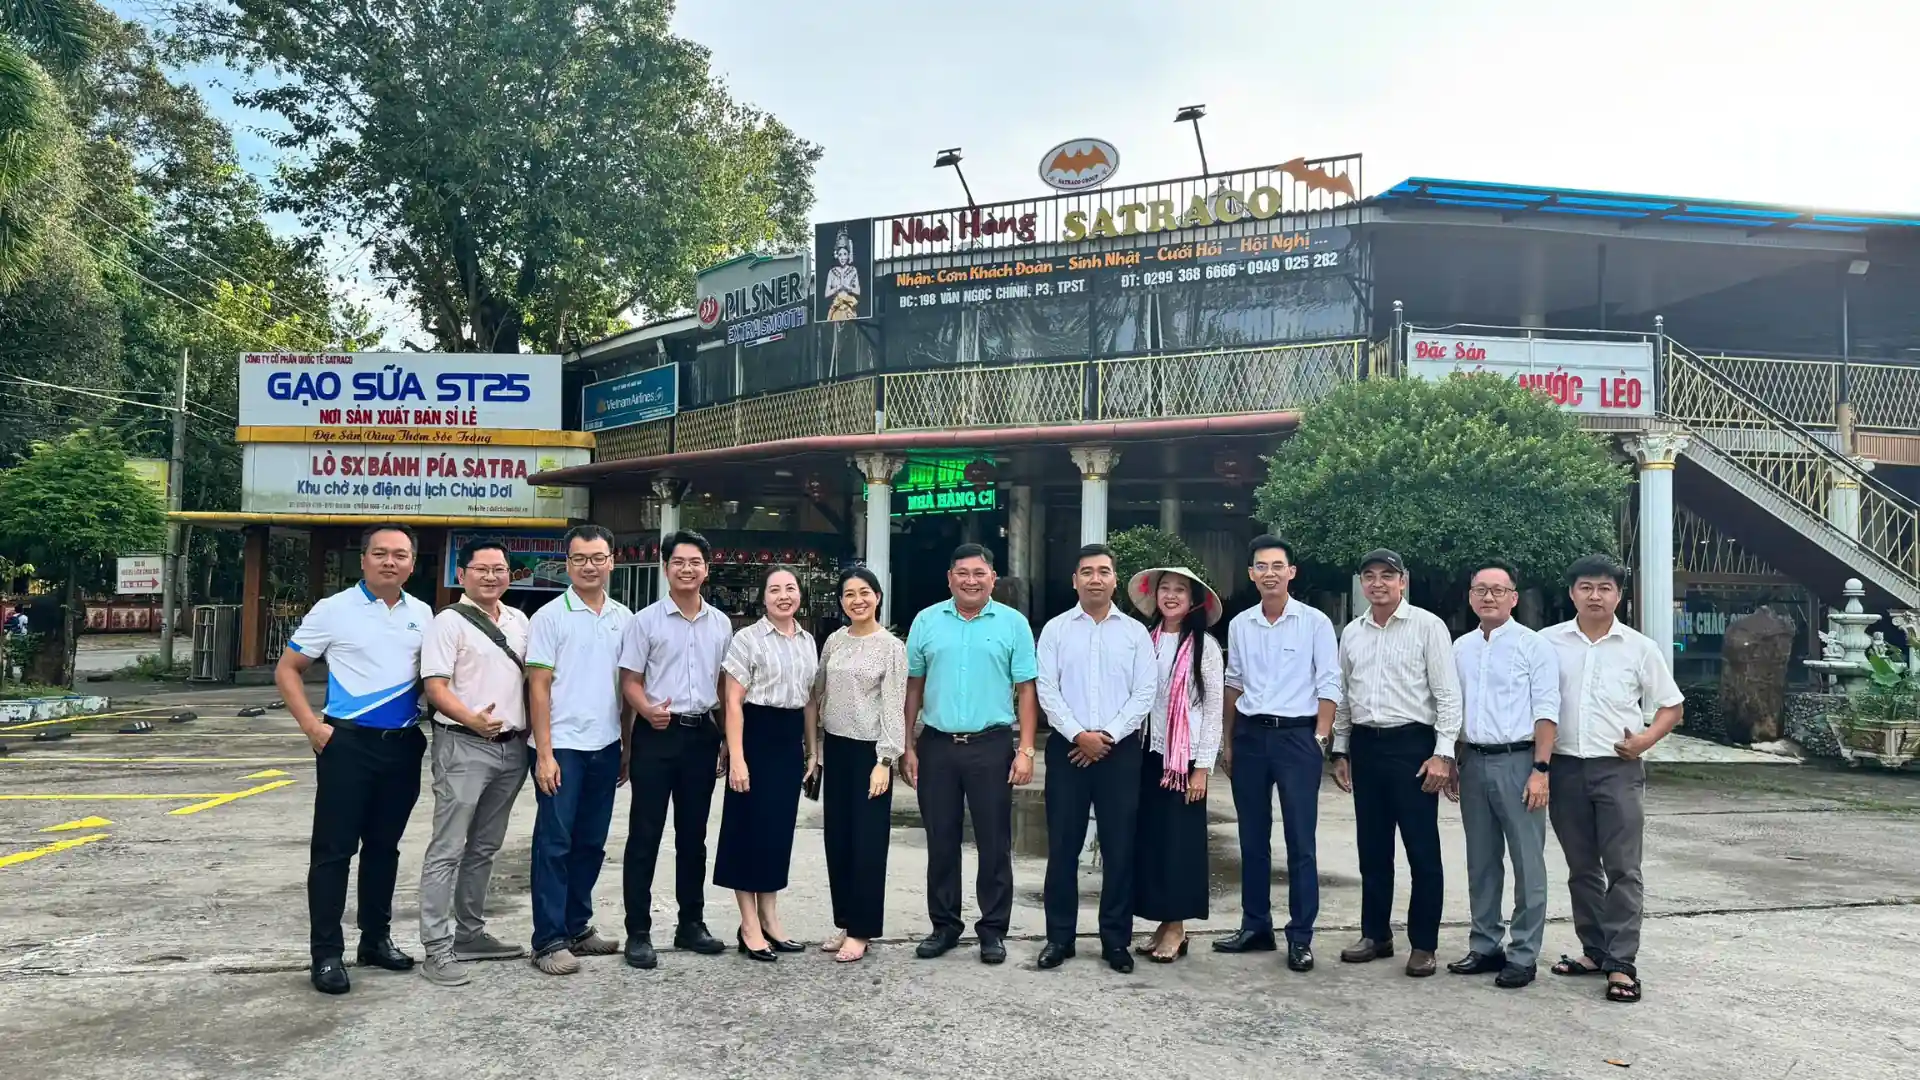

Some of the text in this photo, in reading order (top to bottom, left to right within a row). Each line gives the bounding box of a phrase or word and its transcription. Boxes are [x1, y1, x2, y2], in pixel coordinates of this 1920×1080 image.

[892, 208, 1037, 246] Nhà Hàng
[1062, 185, 1282, 242] SATRACO
[896, 231, 1311, 289] Nhận: Cơm Khách Đoàn Sinh Nhật Cưới Hỏi Hội Nghị
[1121, 252, 1338, 288] ĐT: 0299 368 6666 0949 025 282
[724, 270, 804, 322] PILSNER
[940, 287, 960, 304] VĂN
[963, 288, 992, 304] NGỌC
[995, 282, 1032, 298] CHÍNH,
[1035, 283, 1054, 296] P3,
[1057, 279, 1085, 294] TPST
[727, 306, 806, 345] EXTRA SMOOTH
[262, 355, 270, 364] TY
[325, 355, 354, 364] SATRACO
[1415, 340, 1487, 361] Đặc Sản
[267, 364, 531, 407] GẠO SỮA ST25
[606, 391, 655, 411] Vietnam Airlines
[1600, 368, 1642, 409] LÈO
[319, 408, 342, 424] NƠI
[346, 404, 373, 424] SẢN
[377, 404, 411, 425] XUẤT
[462, 405, 477, 426] LẺ
[312, 449, 336, 476] LÒ
[340, 455, 365, 476] SX
[367, 451, 420, 477] BÁNH
[426, 452, 458, 477] PÍA
[462, 457, 528, 479] SATRA
[297, 480, 320, 495] Khu
[353, 484, 369, 496] xe
[372, 481, 401, 500] điện
[404, 482, 421, 497] du
[425, 482, 447, 499] lịch
[450, 482, 486, 498] Chùa
[490, 483, 513, 498] Dơi
[937, 488, 977, 508] HÀNG
[1696, 603, 1726, 635] CHÀO
